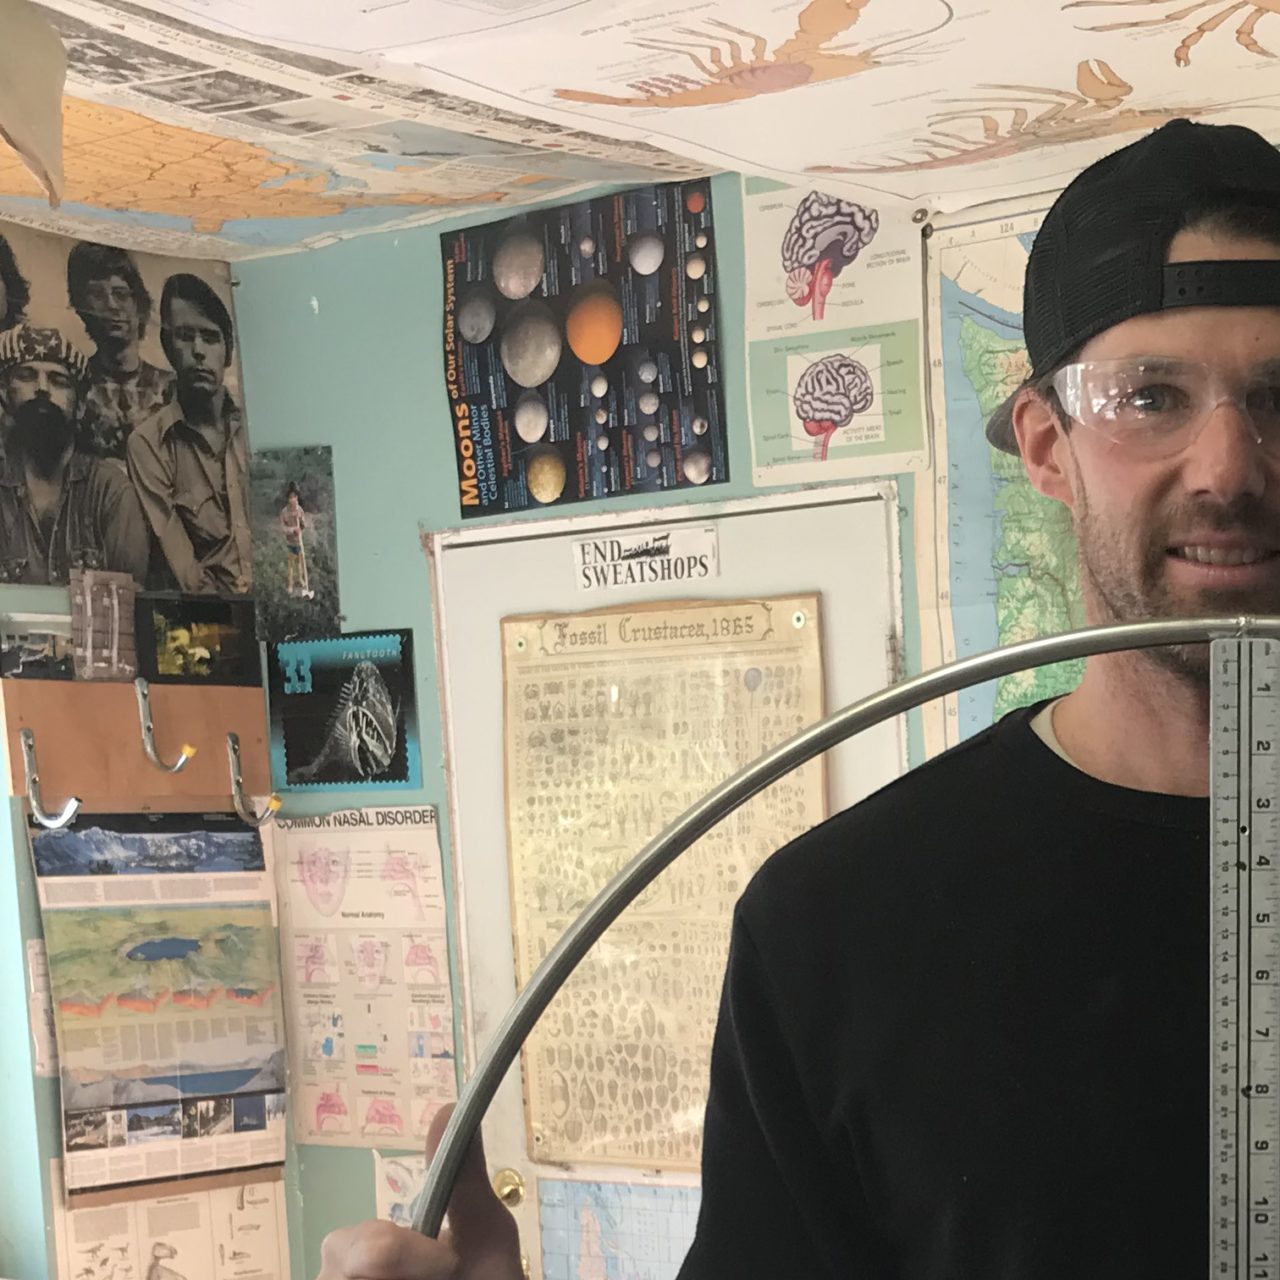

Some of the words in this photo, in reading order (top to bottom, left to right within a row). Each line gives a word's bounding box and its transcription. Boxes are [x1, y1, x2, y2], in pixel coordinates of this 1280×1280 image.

[445, 259, 456, 311] System
[445, 314, 455, 351] Solar
[446, 354, 456, 381] Our
[449, 383, 458, 399] of
[470, 404, 481, 440] Minor
[480, 404, 492, 446] Bodies
[455, 403, 479, 505] Moons
[474, 445, 485, 479] Other
[484, 448, 498, 500] Celestial
[477, 482, 489, 506] and
[580, 539, 622, 566] END
[582, 554, 710, 590] SWEATSHOPS
[554, 621, 608, 649] Fossil
[1257, 683, 1270, 692] 1
[1256, 740, 1270, 751] 2
[1256, 798, 1270, 809] 3
[333, 811, 374, 828] NASAL
[1256, 856, 1270, 867] 4
[1256, 912, 1270, 924] 5
[1256, 970, 1270, 981] 6
[1256, 1028, 1270, 1038] 7
[1256, 1084, 1270, 1095] 8
[1255, 1140, 1270, 1151] 9
[1254, 1197, 1269, 1225] 10
[1254, 1254, 1268, 1280] 11
